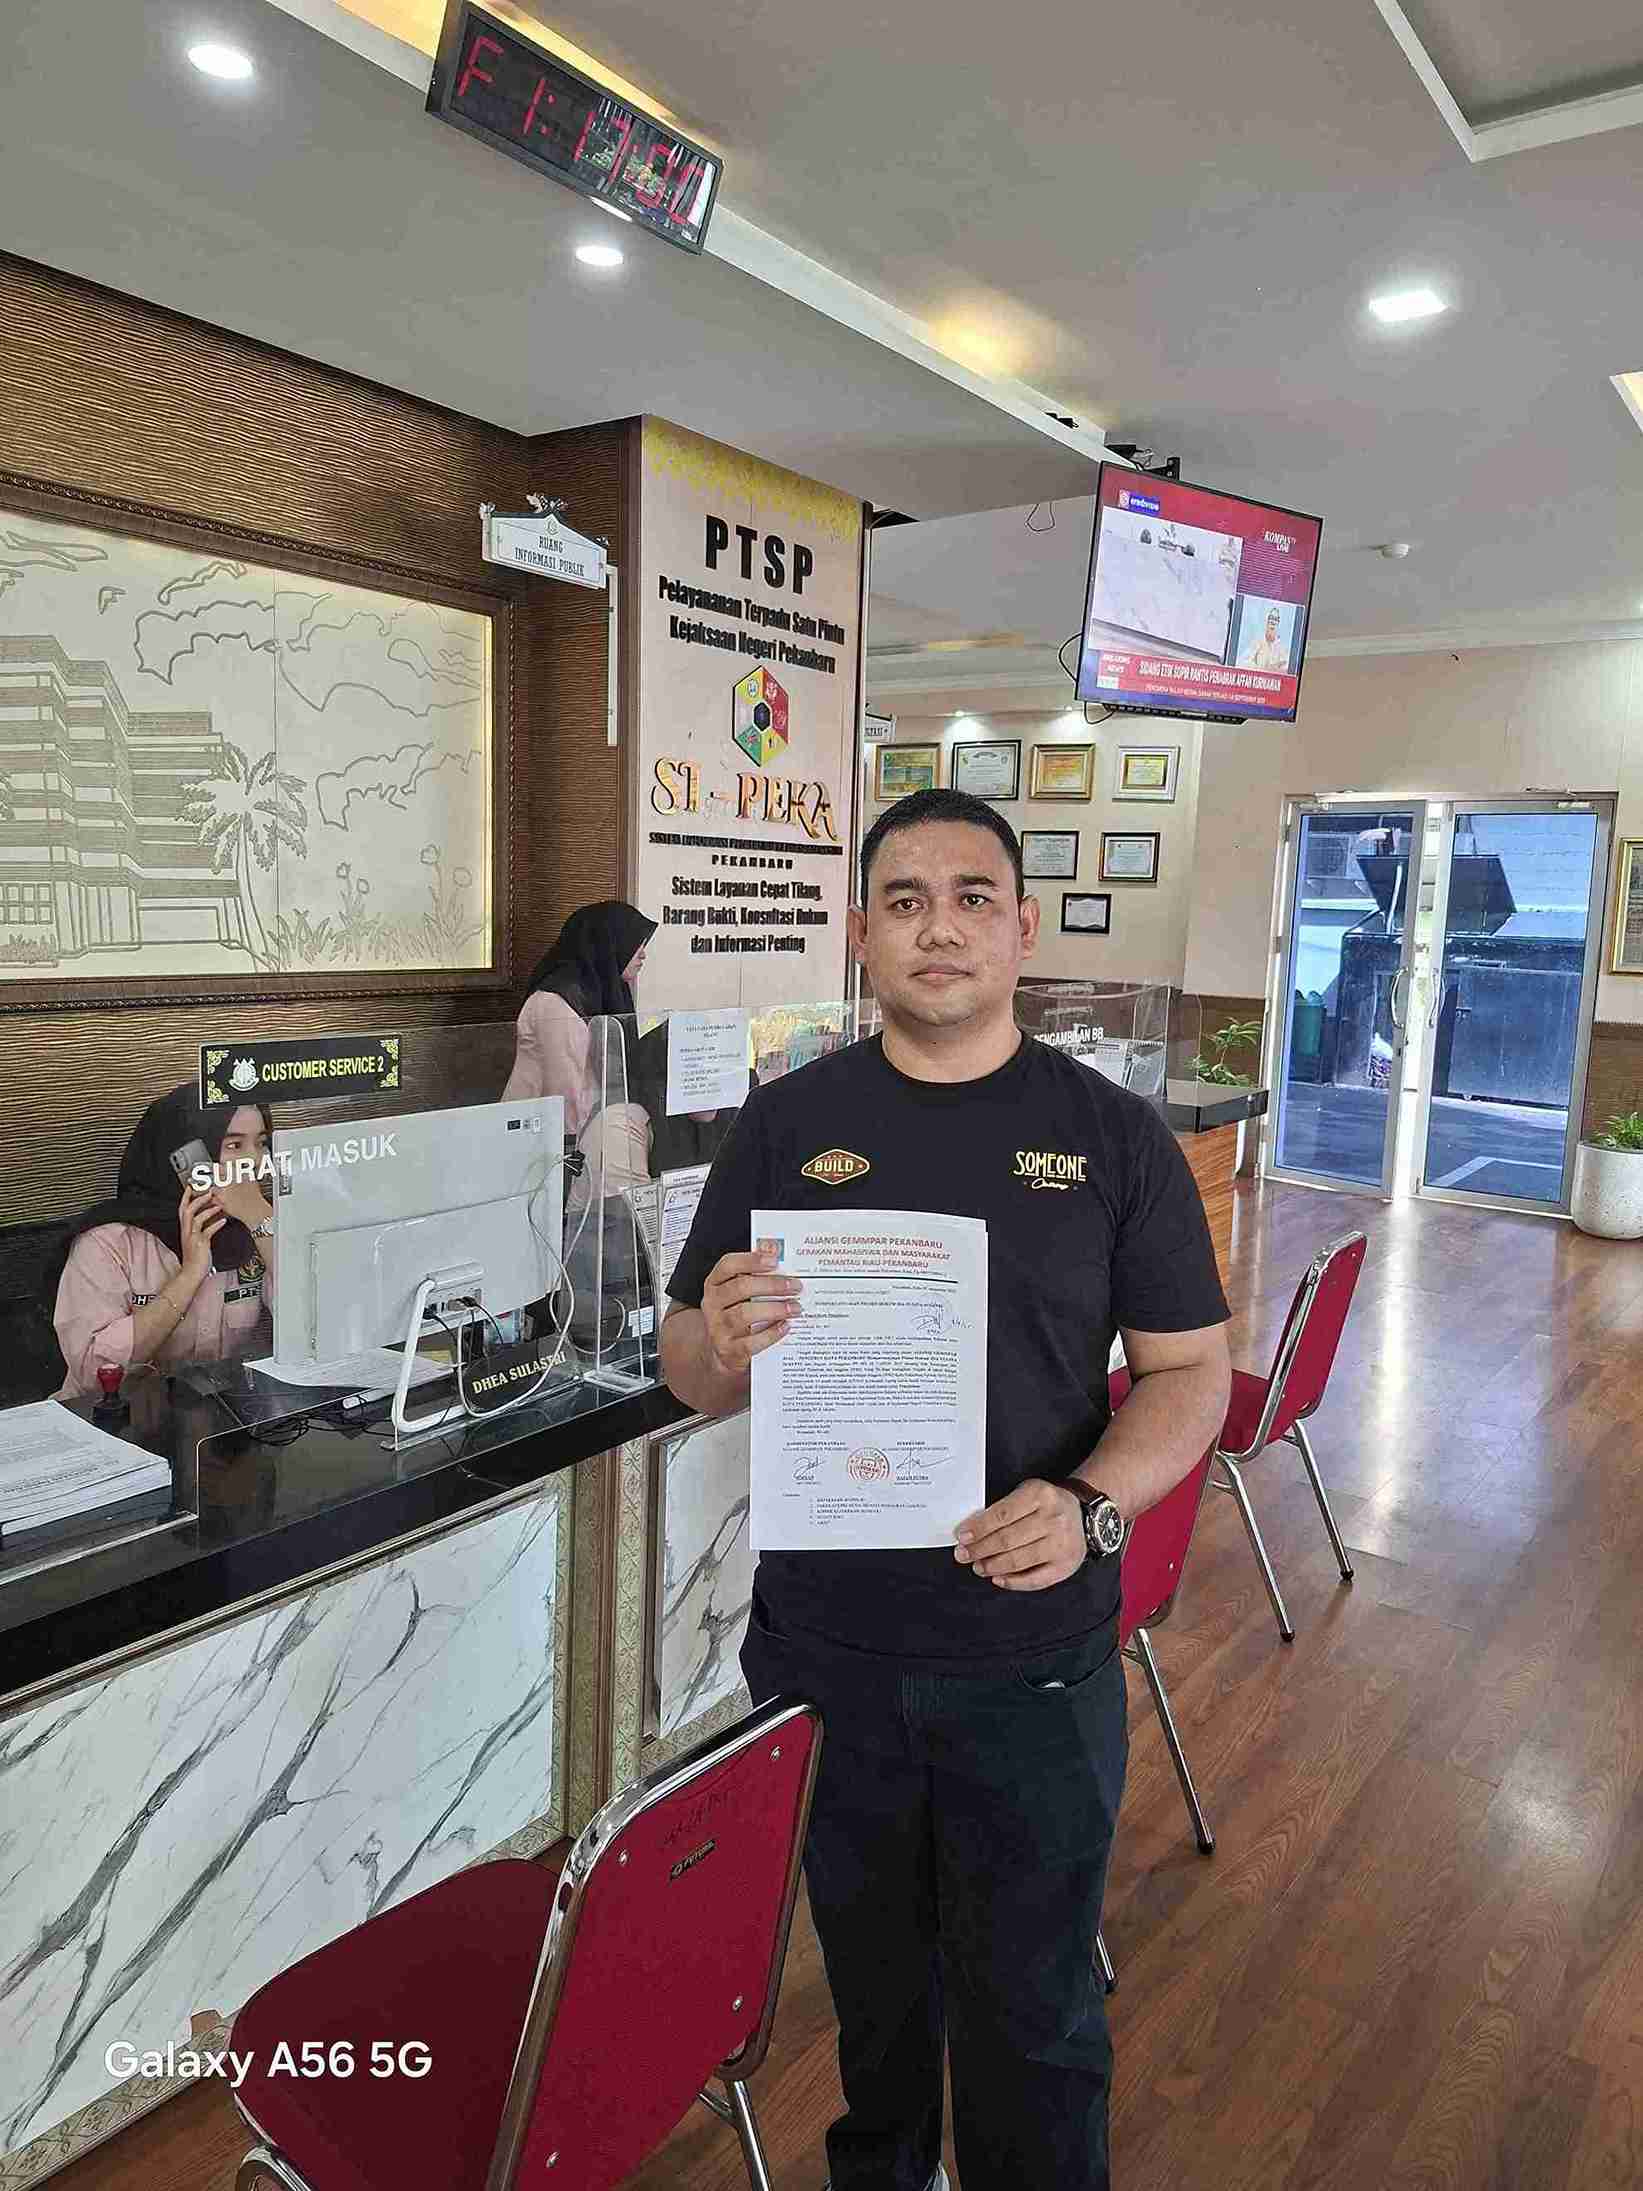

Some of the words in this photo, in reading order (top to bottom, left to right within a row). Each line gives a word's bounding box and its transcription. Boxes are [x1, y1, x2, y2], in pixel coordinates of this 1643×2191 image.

[538, 535, 564, 553] RUANG
[705, 514, 813, 595] PTSP
[514, 547, 557, 570] INFORMASI
[559, 560, 585, 577] PUBLIK
[744, 598, 791, 631] Terpadu
[792, 611, 817, 638] Satu
[669, 615, 737, 652] Kejaksaan
[738, 631, 777, 661] Negeri
[736, 772, 840, 842] PEKA
[711, 854, 793, 870] PEKANBARU
[671, 876, 712, 896] Sistem
[713, 878, 759, 899] Layanan
[760, 880, 790, 899] Cepat
[663, 905, 706, 926] Barang
[740, 906, 795, 926] Konsultasi
[690, 934, 712, 953] dan
[713, 934, 766, 953] Informasi
[767, 934, 806, 954] Penting
[262, 1061, 327, 1082] CUSTOMER
[328, 1056, 376, 1077] SERVICE
[377, 1055, 384, 1073] 2
[187, 1150, 293, 1192] SURAT
[301, 1133, 398, 1172] MASUK
[815, 1159, 854, 1173] BUILD
[1013, 1151, 1087, 1182] SOMEONE
[472, 1373, 509, 1395] DHEA
